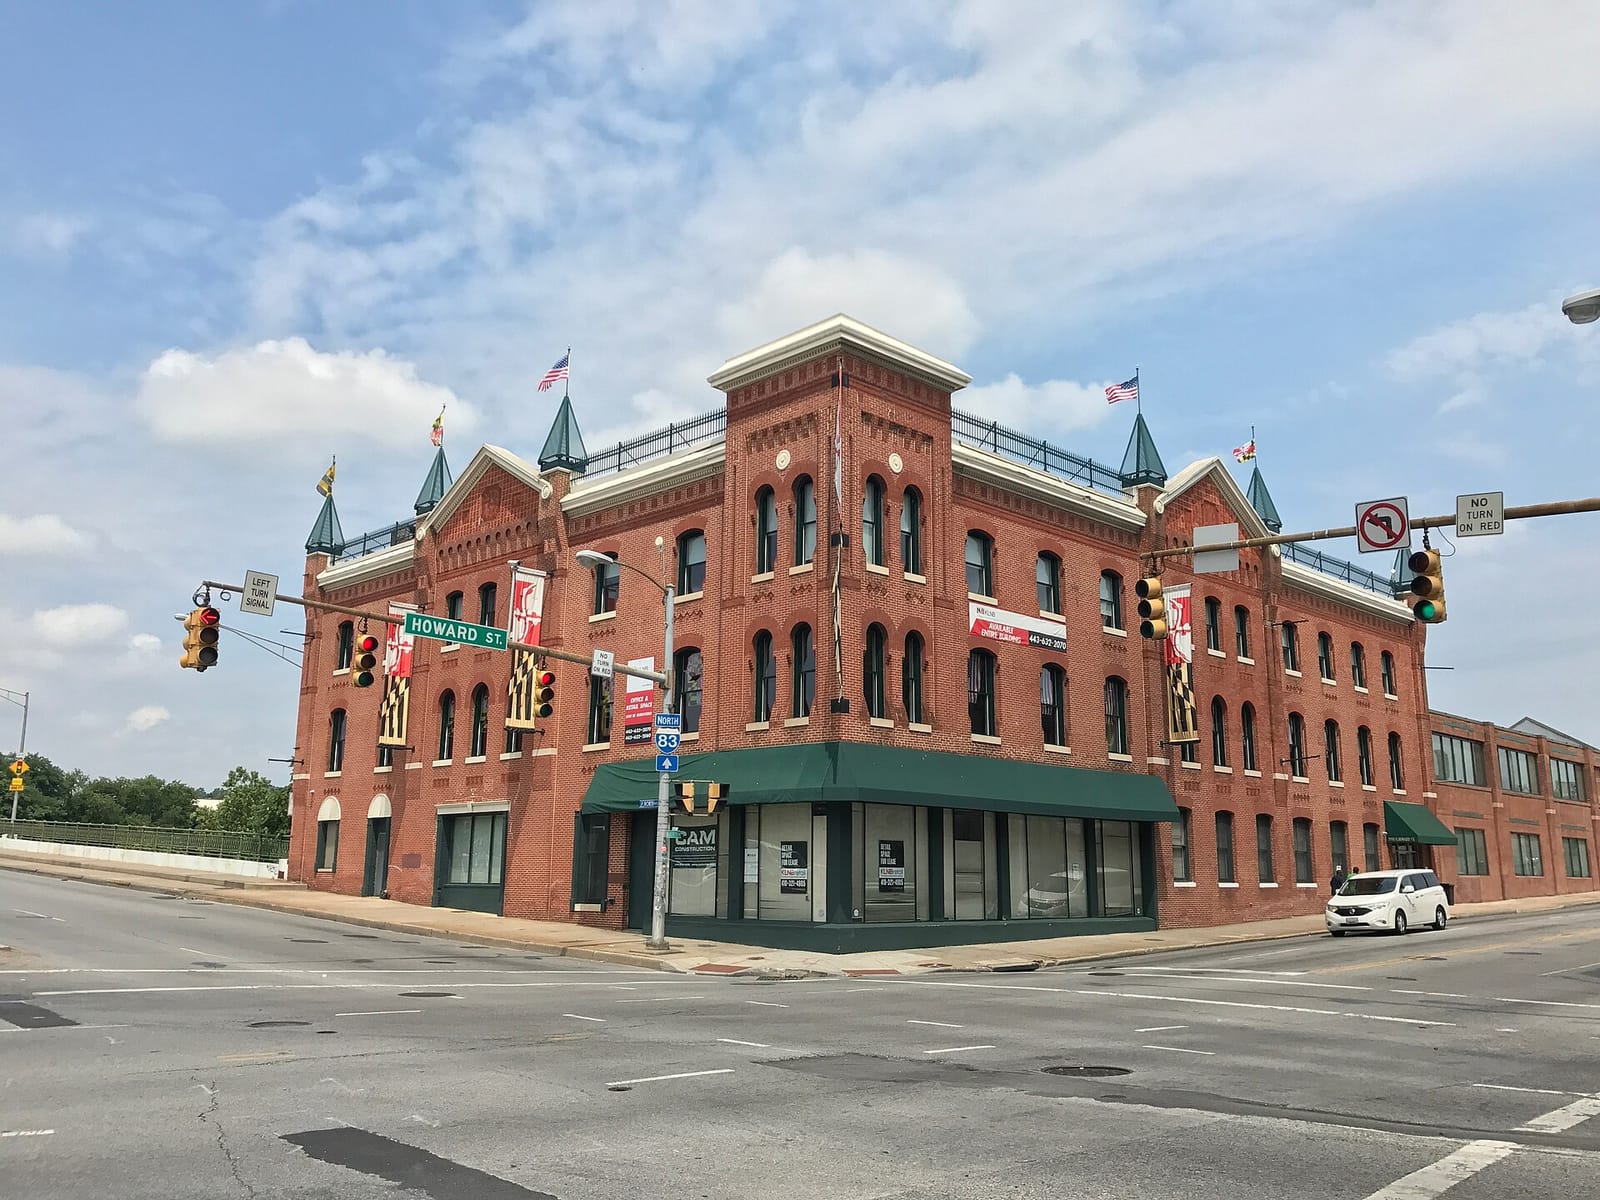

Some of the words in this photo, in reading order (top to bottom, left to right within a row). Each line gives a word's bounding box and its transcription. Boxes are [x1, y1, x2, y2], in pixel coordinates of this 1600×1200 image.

[1471, 498, 1488, 507] NO
[1466, 509, 1493, 520] TURN
[1459, 523, 1473, 532] ON
[1480, 521, 1500, 531] RED
[252, 577, 271, 588] LEFT
[251, 588, 269, 599] TURN
[245, 597, 270, 609] SIGNAL
[411, 617, 478, 641] HOWARD
[485, 632, 503, 645] ST.
[988, 622, 1015, 635] AVAILABLE
[981, 628, 1000, 639] ENTIRE
[999, 632, 1022, 644] BUILDING
[1029, 634, 1067, 650] 443-632-2070
[597, 659, 610, 667] TURN
[601, 667, 611, 675] RED
[657, 715, 679, 725] NORTH
[658, 734, 677, 748] 83
[675, 829, 716, 845] CAM
